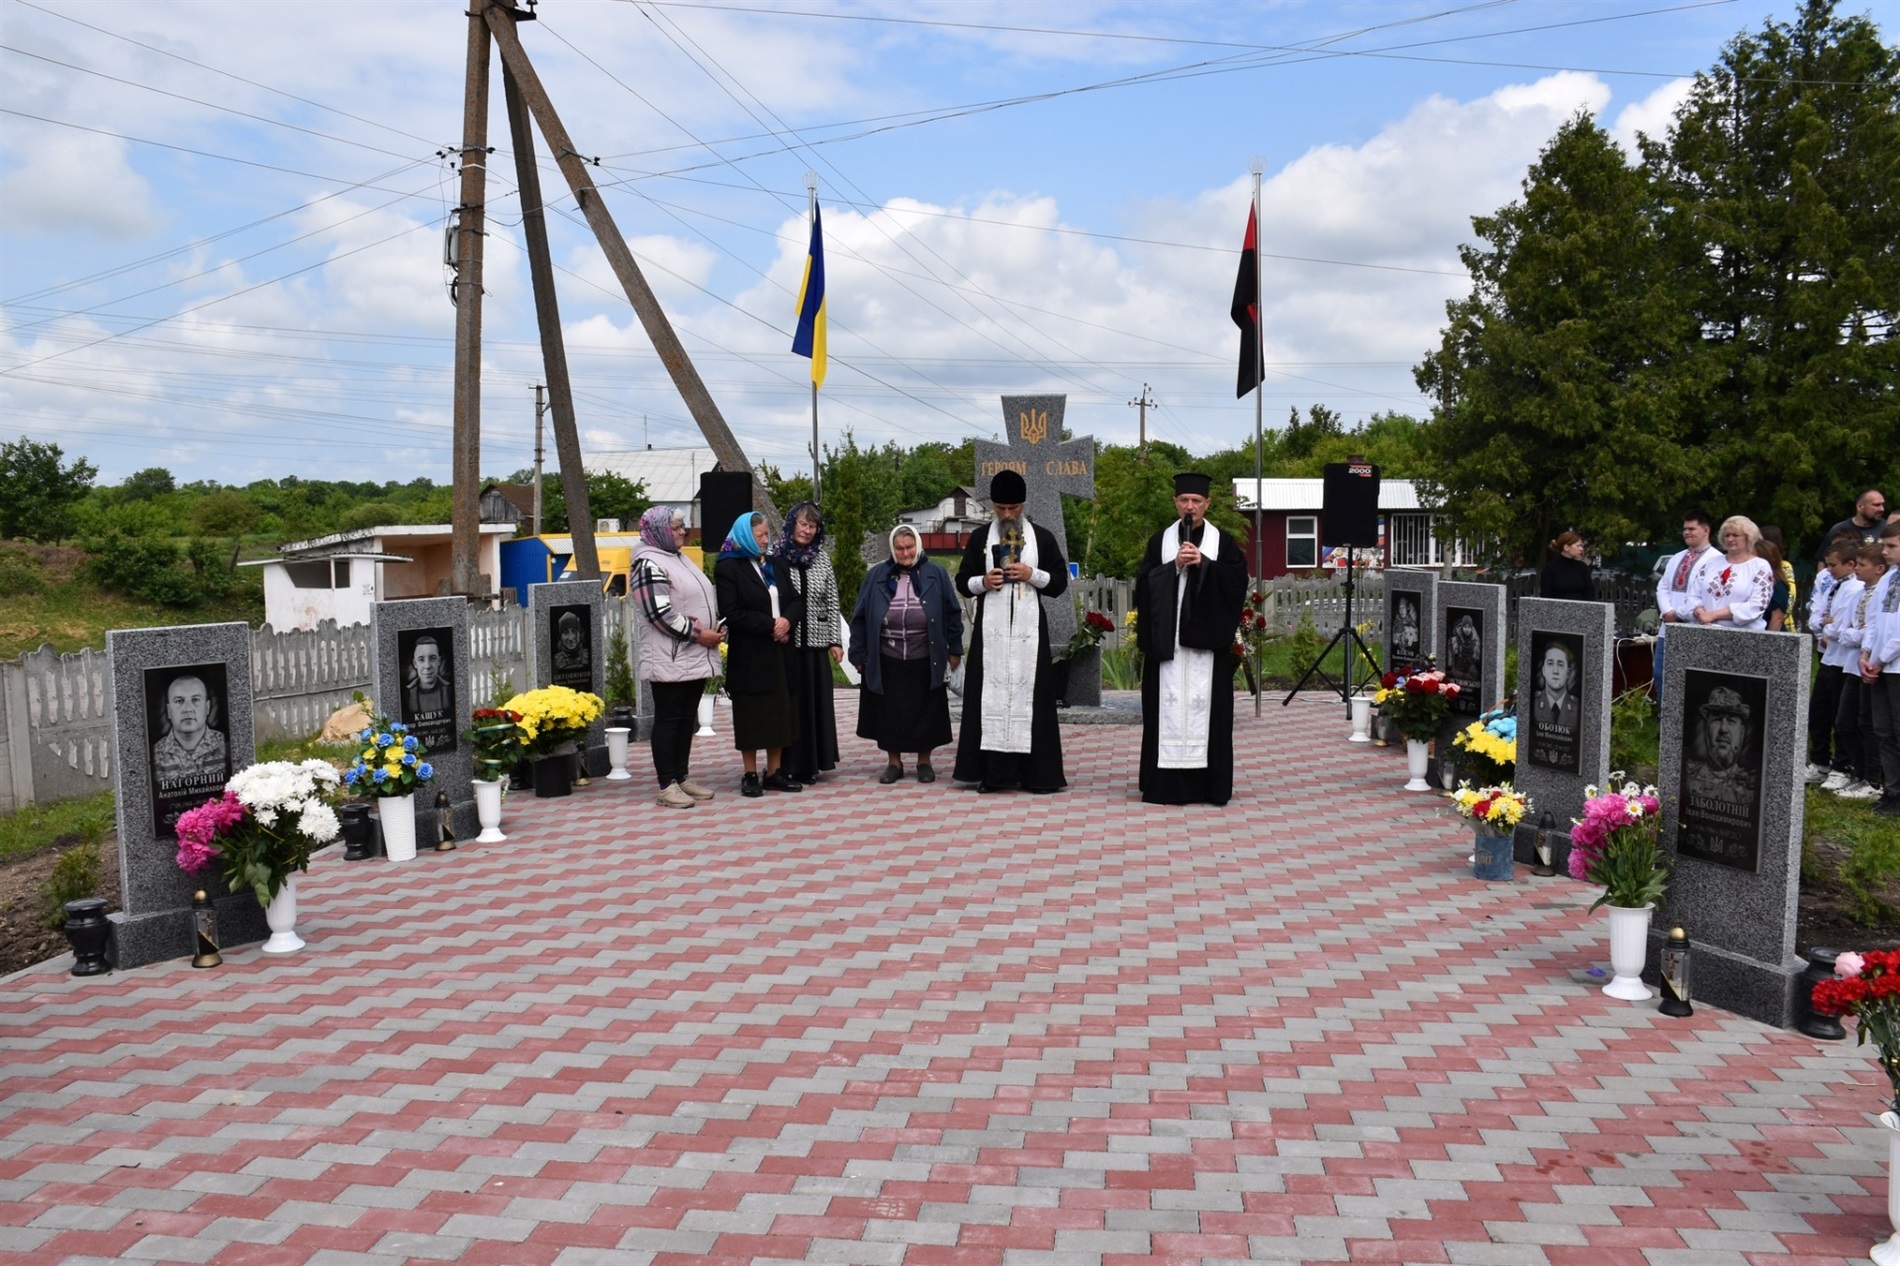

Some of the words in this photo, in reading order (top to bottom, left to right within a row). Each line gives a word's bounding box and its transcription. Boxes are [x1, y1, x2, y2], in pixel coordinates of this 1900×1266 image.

[981, 461, 1027, 476] ГЕРОЯМ
[1046, 461, 1087, 476] СЛАВА
[414, 710, 444, 721] КАЩУК
[1538, 721, 1571, 735] ОБОЗЮК
[161, 771, 224, 790] НАГОРНИЙ
[159, 788, 187, 799] Анатолій
